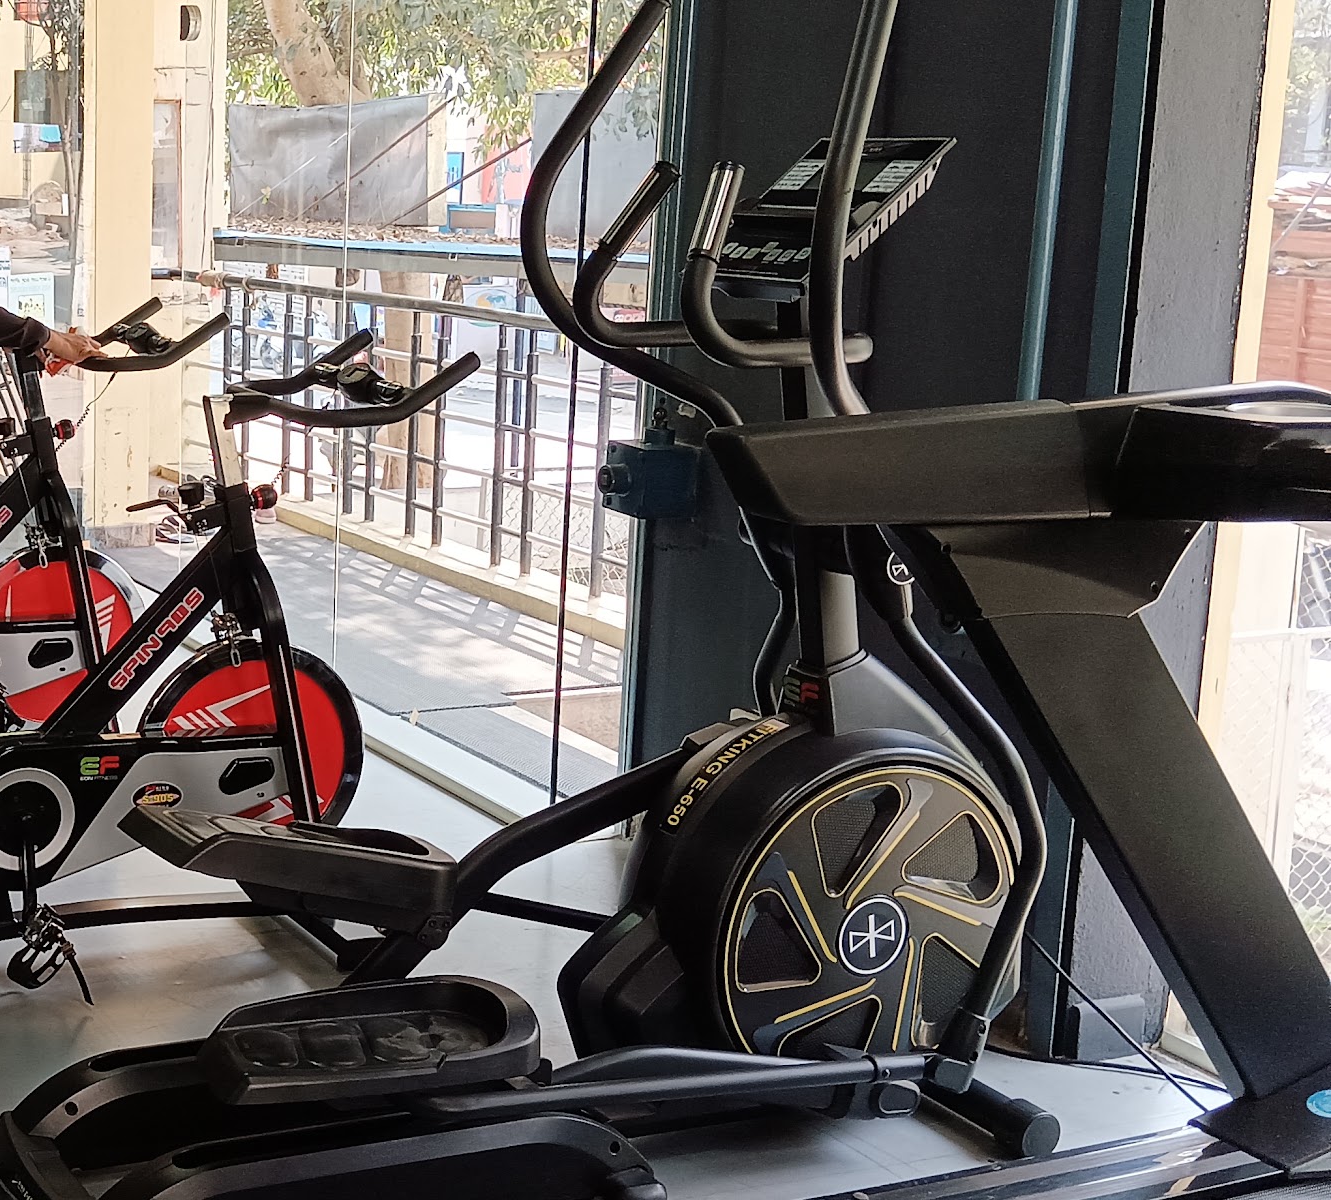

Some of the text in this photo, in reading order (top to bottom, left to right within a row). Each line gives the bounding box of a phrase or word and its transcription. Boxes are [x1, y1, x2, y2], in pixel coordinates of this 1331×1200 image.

[108, 634, 163, 691] SPIN
[80, 756, 120, 775] EF
[667, 722, 779, 826] FITKING E-650
